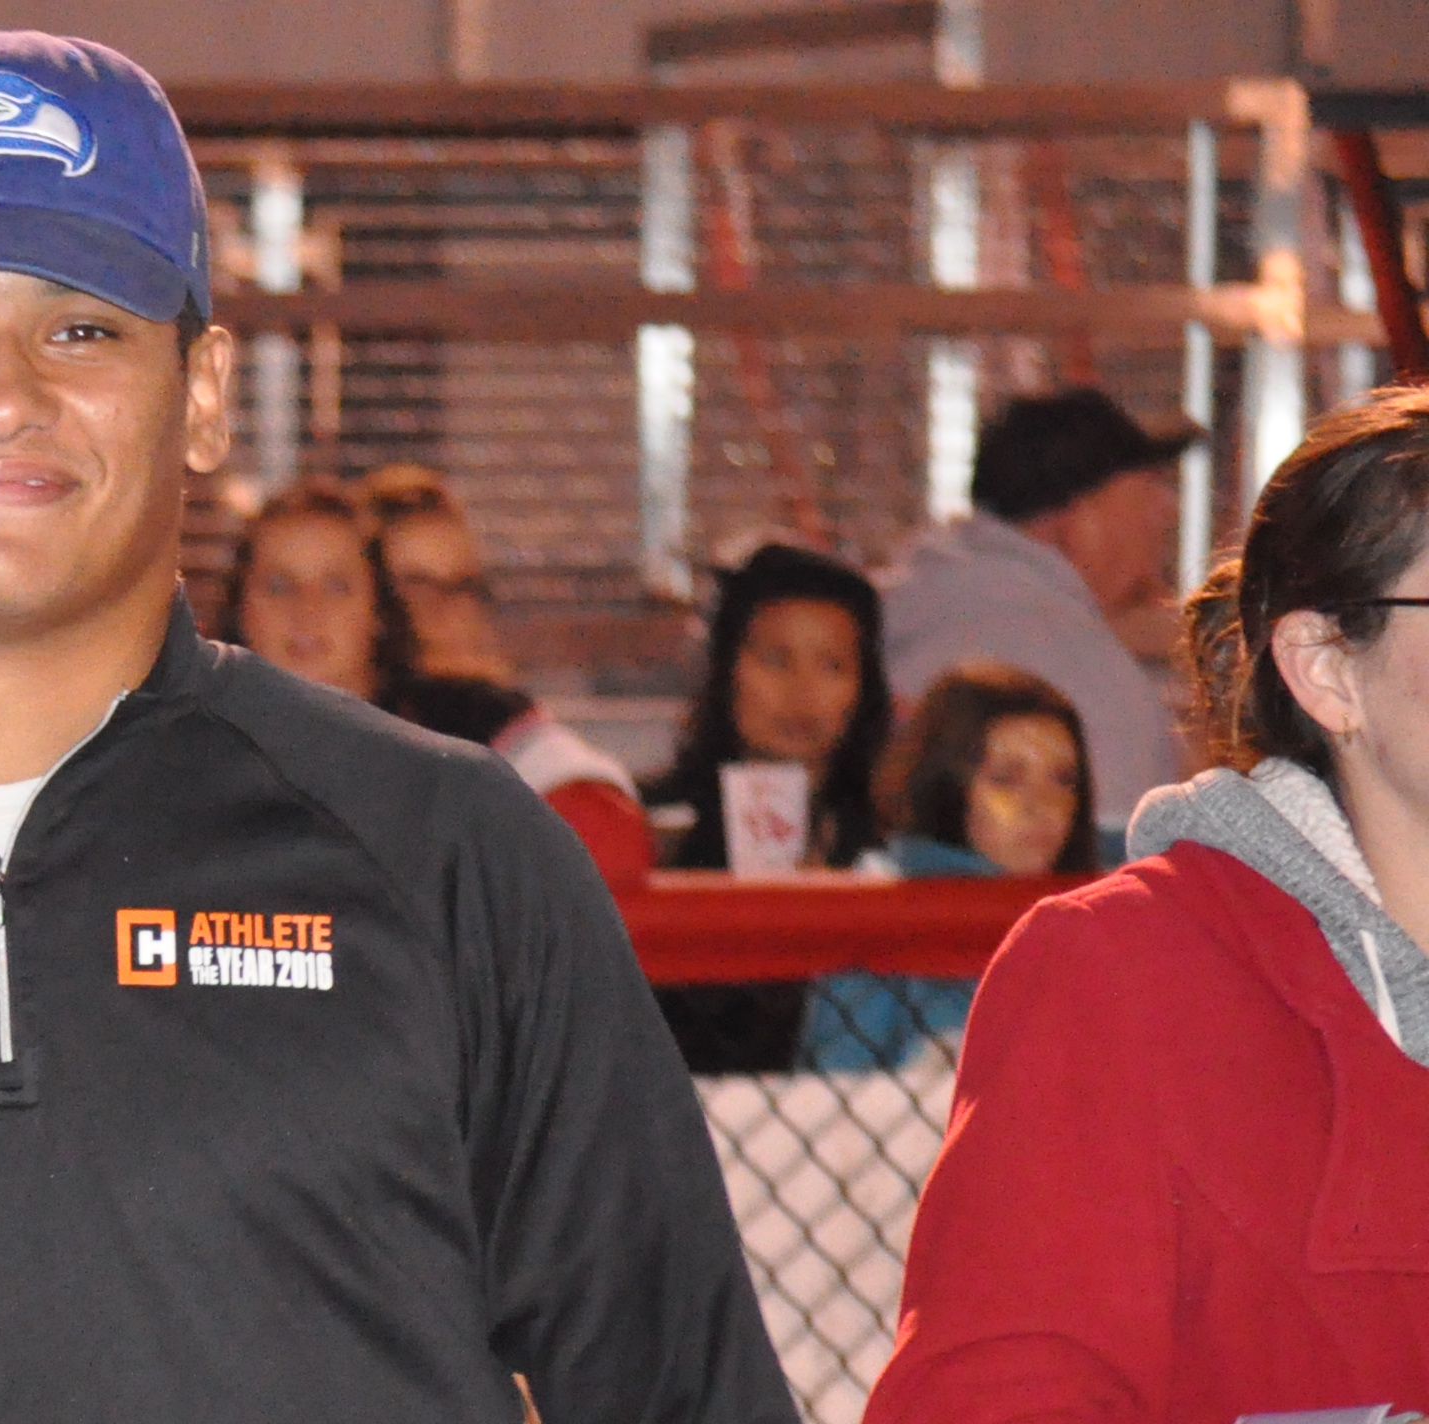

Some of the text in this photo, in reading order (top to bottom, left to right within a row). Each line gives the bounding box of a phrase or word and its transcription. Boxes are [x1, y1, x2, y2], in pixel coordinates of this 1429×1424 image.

[189, 911, 333, 951] ATHLETE
[187, 946, 214, 966] OF
[216, 946, 334, 991] YEAR 2016
[190, 965, 219, 986] THE
